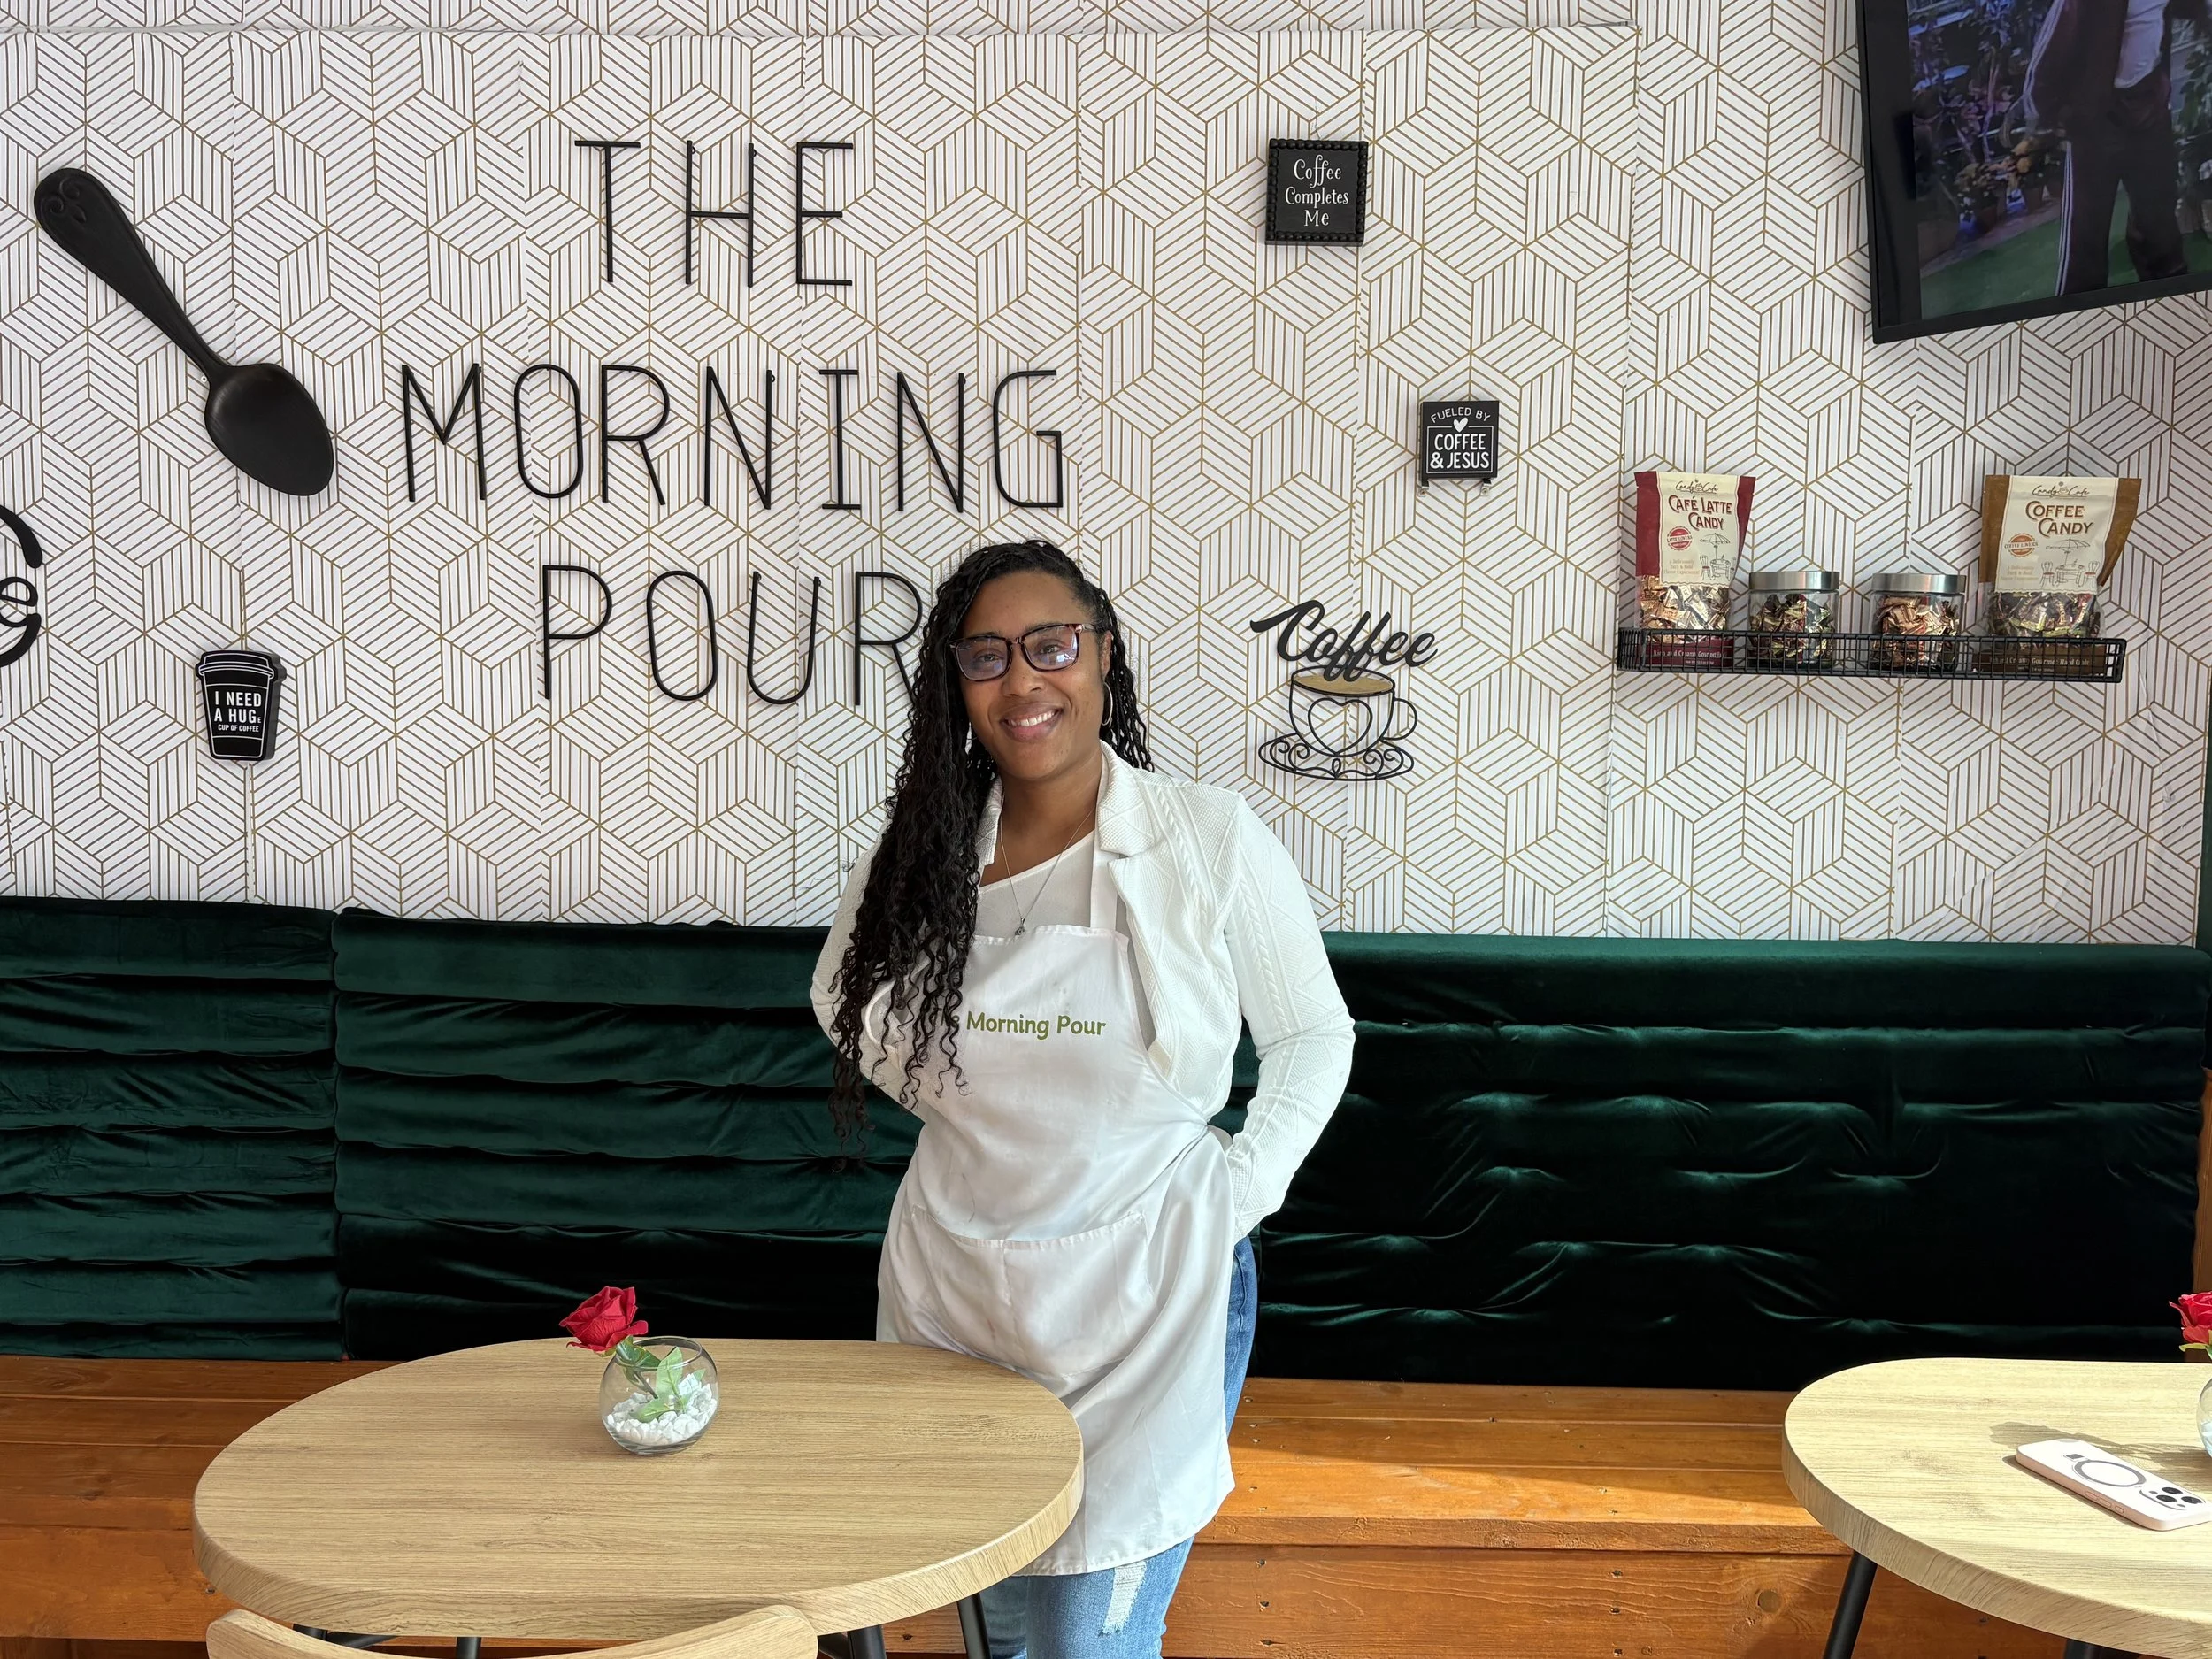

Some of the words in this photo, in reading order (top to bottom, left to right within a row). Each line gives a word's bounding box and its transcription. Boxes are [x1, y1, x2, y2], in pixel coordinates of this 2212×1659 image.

[1294, 154, 1342, 188] Coffee
[1285, 186, 1349, 209] Completes
[575, 140, 854, 288] THE
[1303, 209, 1329, 227] Me
[1430, 406, 1472, 424] FUELED
[1475, 410, 1491, 422] BY
[401, 362, 1064, 514] MORNING
[1434, 433, 1486, 451] COFFEE
[1430, 451, 1444, 469] &
[1446, 451, 1490, 469] JESUS
[2032, 485, 2060, 498] Candy
[1701, 496, 1732, 515] LATTE
[2025, 500, 2085, 521] COFFEE
[1687, 511, 1724, 531] CANDY
[2038, 517, 2094, 538] CANDY
[541, 565, 922, 706] POUR
[1249, 599, 1439, 682] Coffee
[215, 691, 219, 705] I
[226, 691, 262, 707] NEED
[213, 707, 223, 722] A
[228, 708, 262, 724] HUGE
[966, 1010, 1050, 1041] Morning
[1056, 1014, 1107, 1036] Pour
